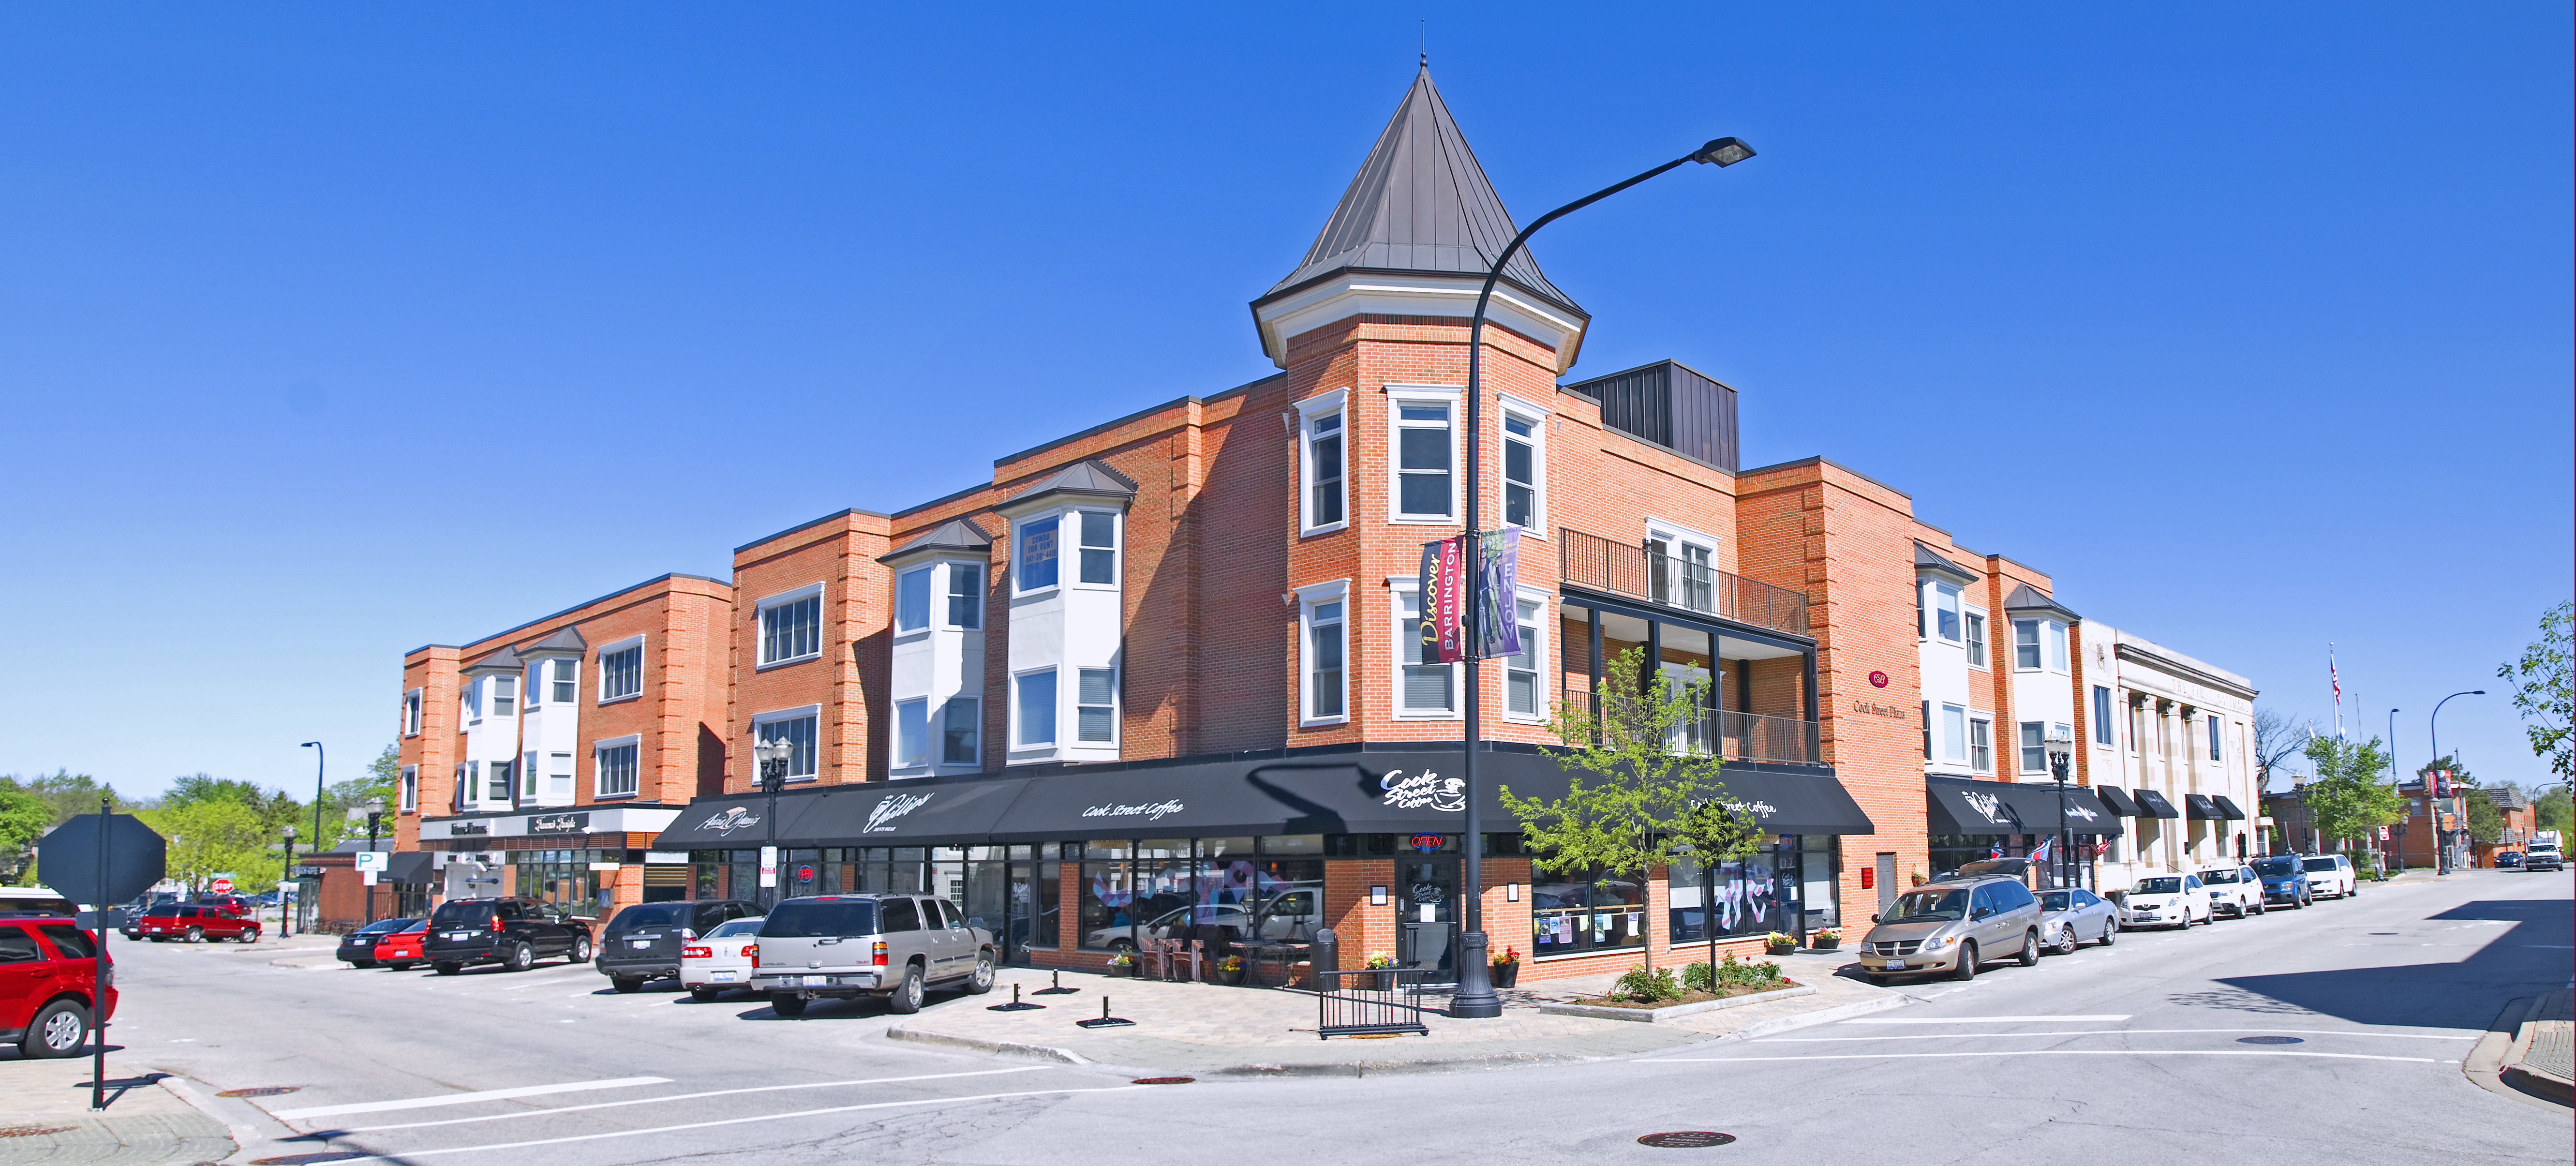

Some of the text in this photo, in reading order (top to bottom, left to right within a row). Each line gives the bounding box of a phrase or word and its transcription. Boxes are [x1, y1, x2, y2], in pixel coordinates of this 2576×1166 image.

[1420, 553, 1441, 646] Discover
[1444, 542, 1457, 651] BARRINGTON
[1503, 562, 1514, 639] ENJOY
[1854, 700, 1906, 719] Cook Street Plaza
[1380, 768, 1440, 790] Cook
[1383, 782, 1437, 805] Street
[1398, 797, 1433, 808] Coffee
[863, 792, 935, 833] Phillips
[1082, 799, 1184, 821] Cook Street Coffee
[1747, 800, 1777, 819] Coffee
[1411, 836, 1443, 846] OPEN
[359, 854, 373, 868] P
[1413, 883, 1433, 894] Cook
